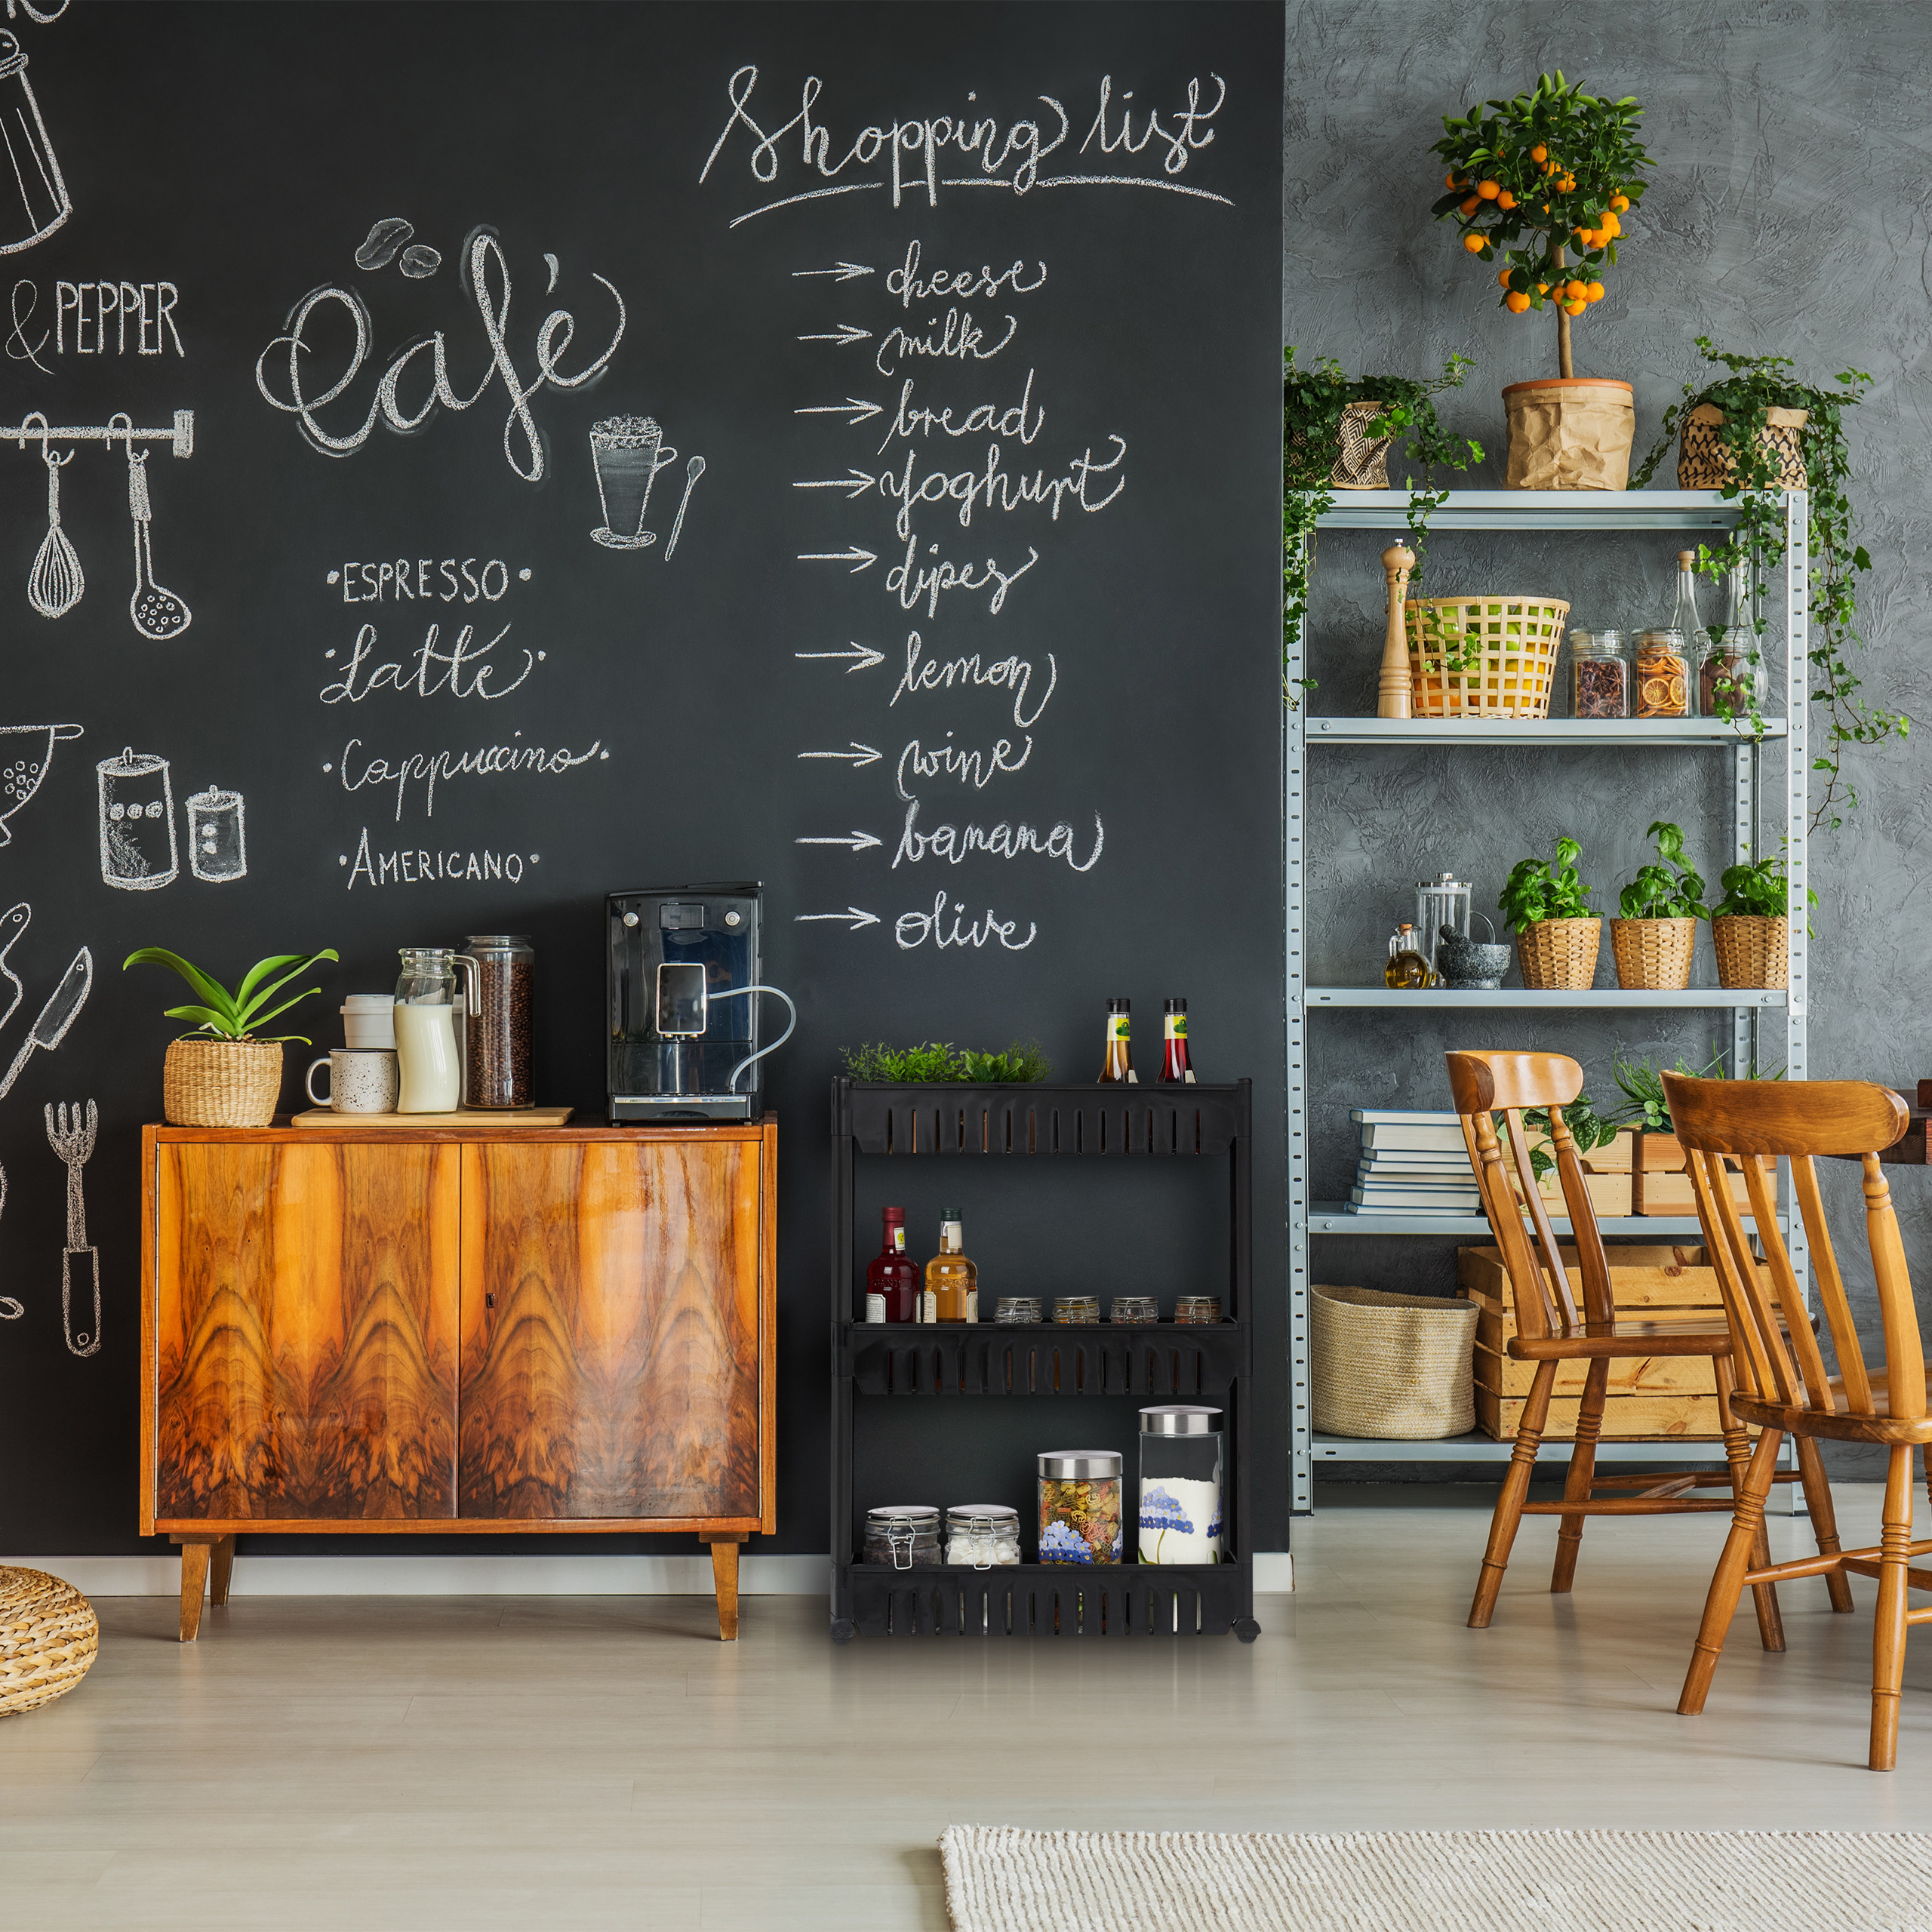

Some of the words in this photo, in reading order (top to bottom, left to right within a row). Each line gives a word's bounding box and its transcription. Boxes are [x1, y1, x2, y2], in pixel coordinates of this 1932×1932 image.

[1080, 72, 1225, 174] list
[887, 239, 1047, 308] cheese
[57, 281, 184, 357] PEPPER
[877, 307, 1017, 377] milk
[878, 368, 1045, 455] bread
[343, 558, 509, 603] ESPRESSO
[320, 622, 533, 704] Latte
[890, 631, 1057, 728] lemon
[341, 729, 601, 822] Cappuccino
[897, 731, 1032, 800] wine
[892, 800, 1104, 872] banana
[895, 891, 1037, 950] olive
